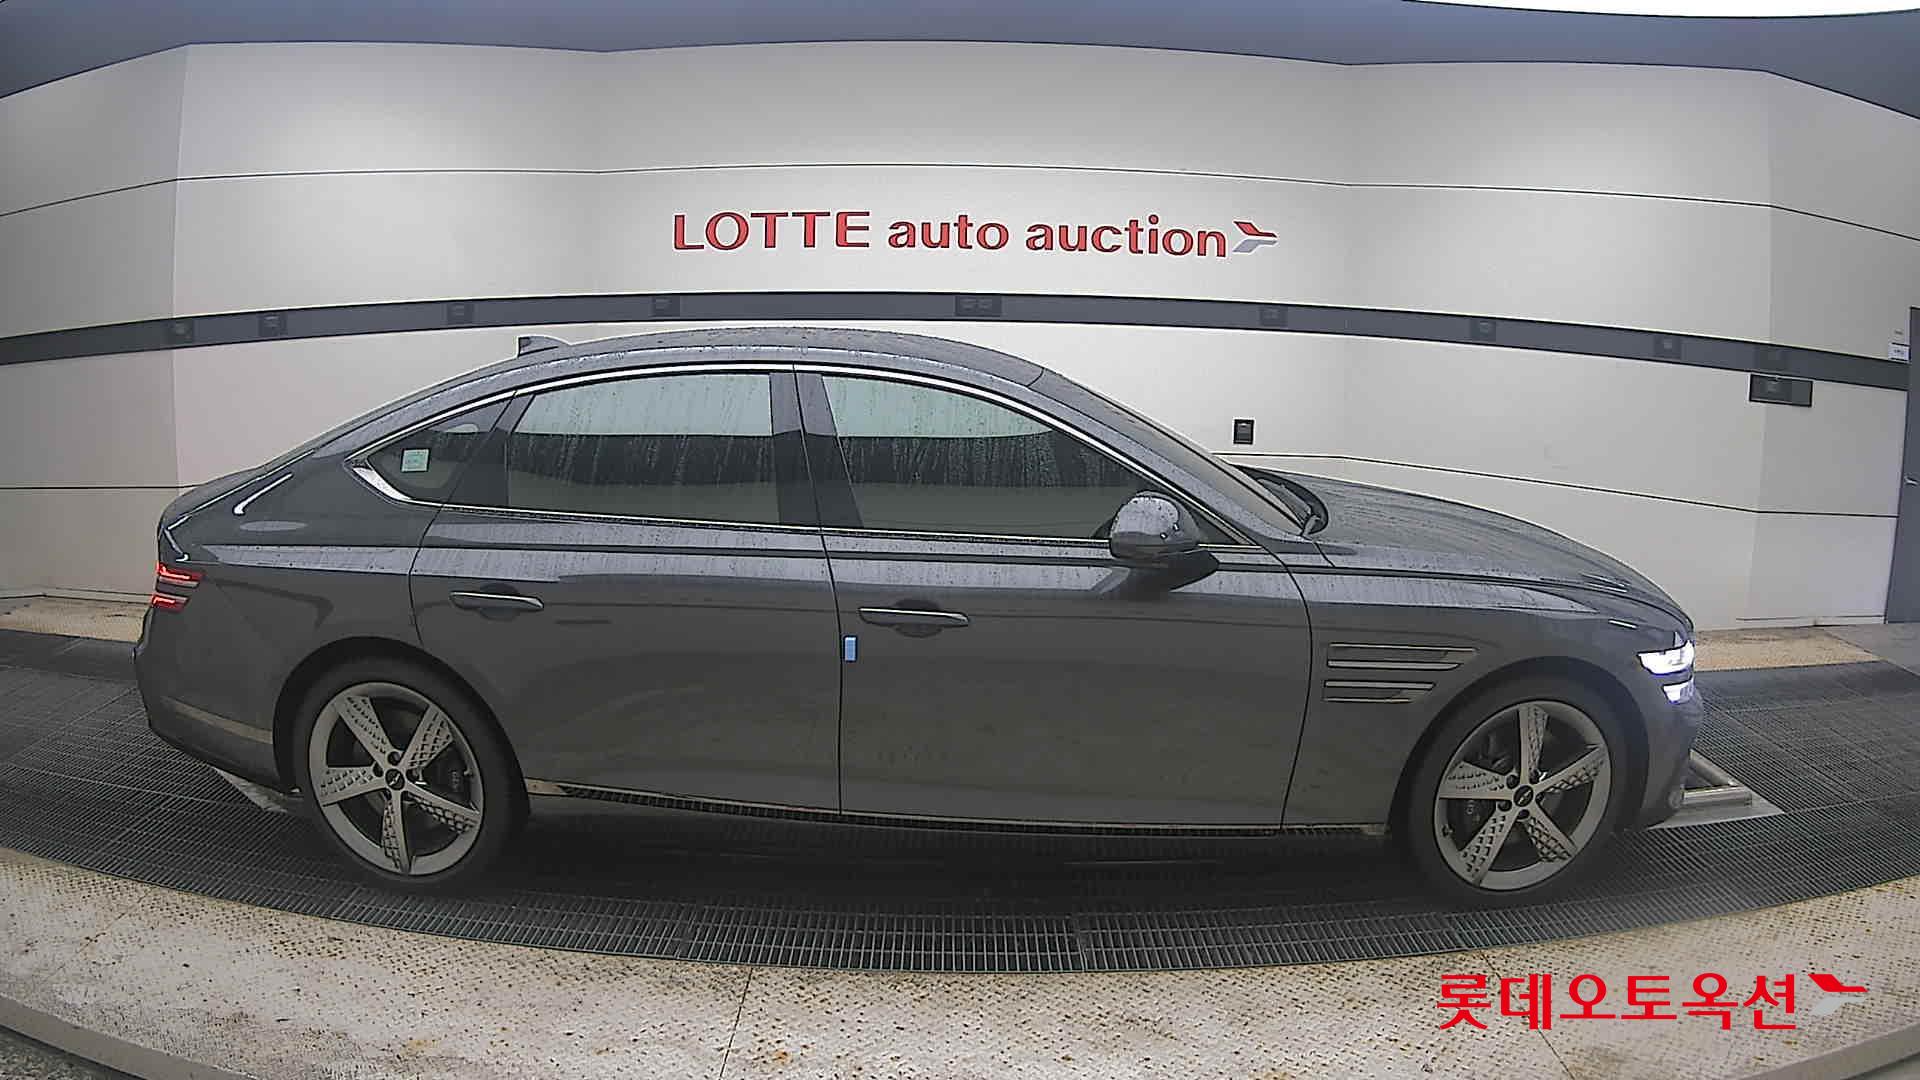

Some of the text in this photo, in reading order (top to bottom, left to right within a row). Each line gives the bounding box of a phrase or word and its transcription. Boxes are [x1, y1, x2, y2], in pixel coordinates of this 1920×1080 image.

[674, 211, 1227, 258] LOTTE auto auction
